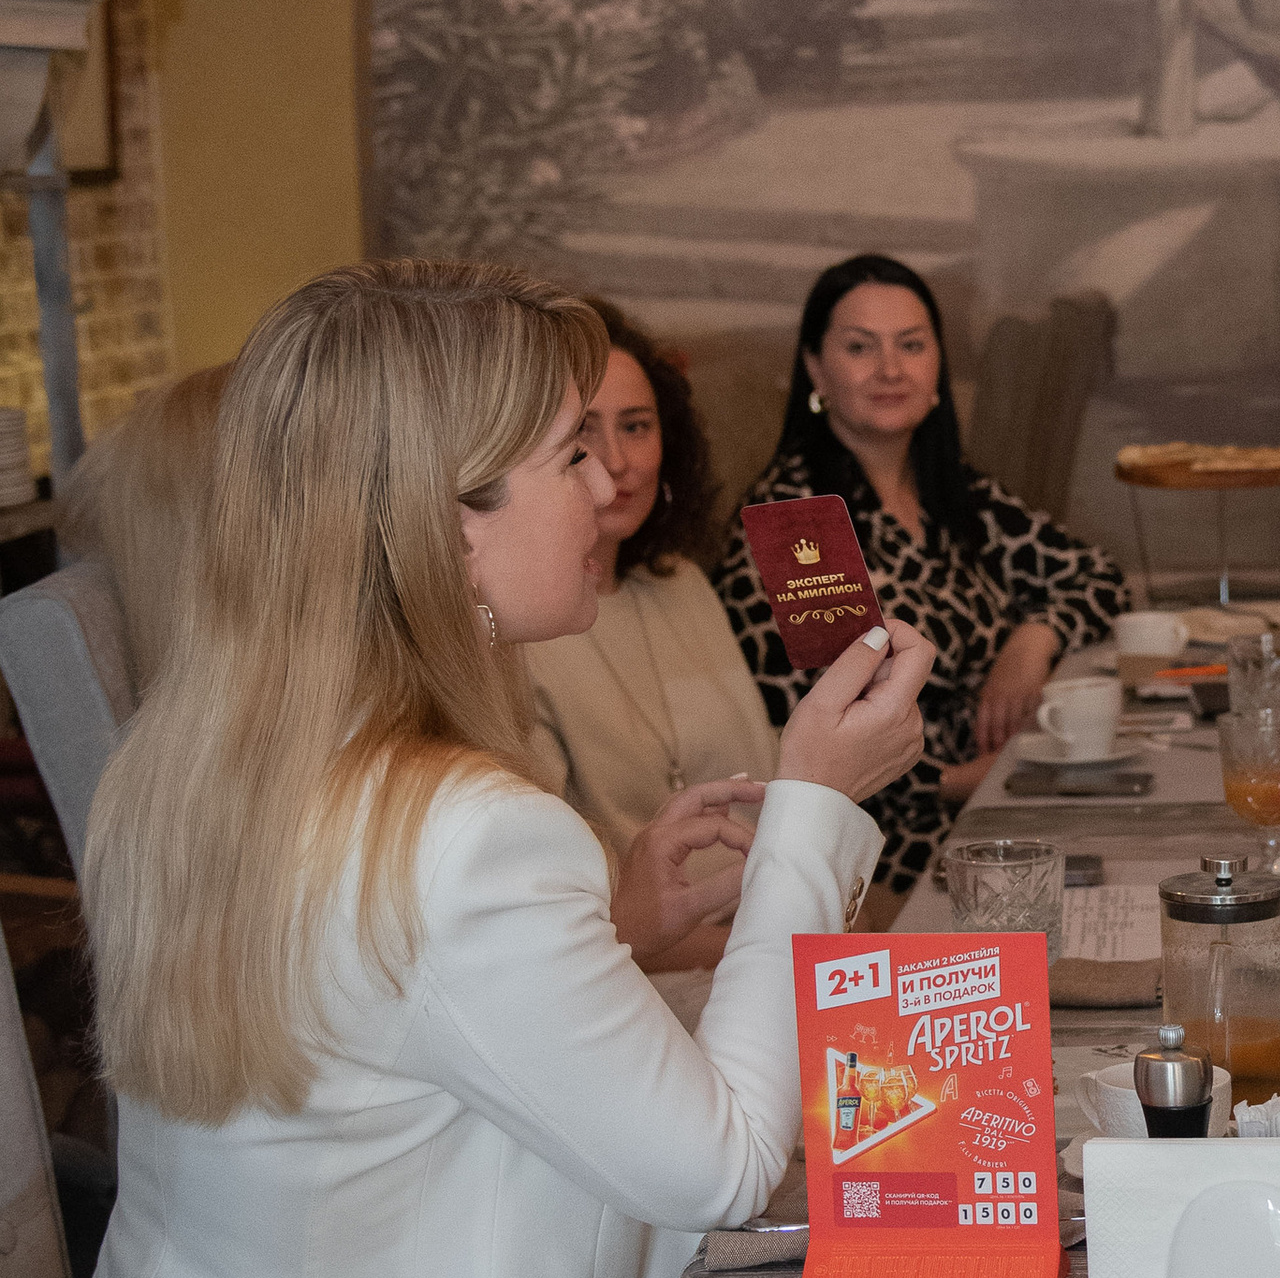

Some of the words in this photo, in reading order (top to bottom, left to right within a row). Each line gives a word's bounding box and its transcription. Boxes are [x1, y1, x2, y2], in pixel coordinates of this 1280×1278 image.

[776, 592, 797, 603] НА
[797, 583, 863, 599] МИЛЛИОН
[786, 573, 845, 589] ЭКСПЕРТ
[897, 959, 940, 974] ЗАКАЖИ
[942, 956, 948, 965] 2
[949, 946, 1000, 962] КОКТЕЙЛЯ
[828, 962, 880, 997] 2+1
[902, 979, 915, 995] И
[920, 963, 996, 991] ПОЛУЧИ
[923, 994, 931, 1005] В
[934, 981, 996, 1003] ПОДАРОК
[907, 1002, 1031, 1056] APEROL
[975, 1088, 1004, 1099] RICETTA
[960, 1106, 1036, 1137] APERITIVO
[984, 1127, 1004, 1139] DAL
